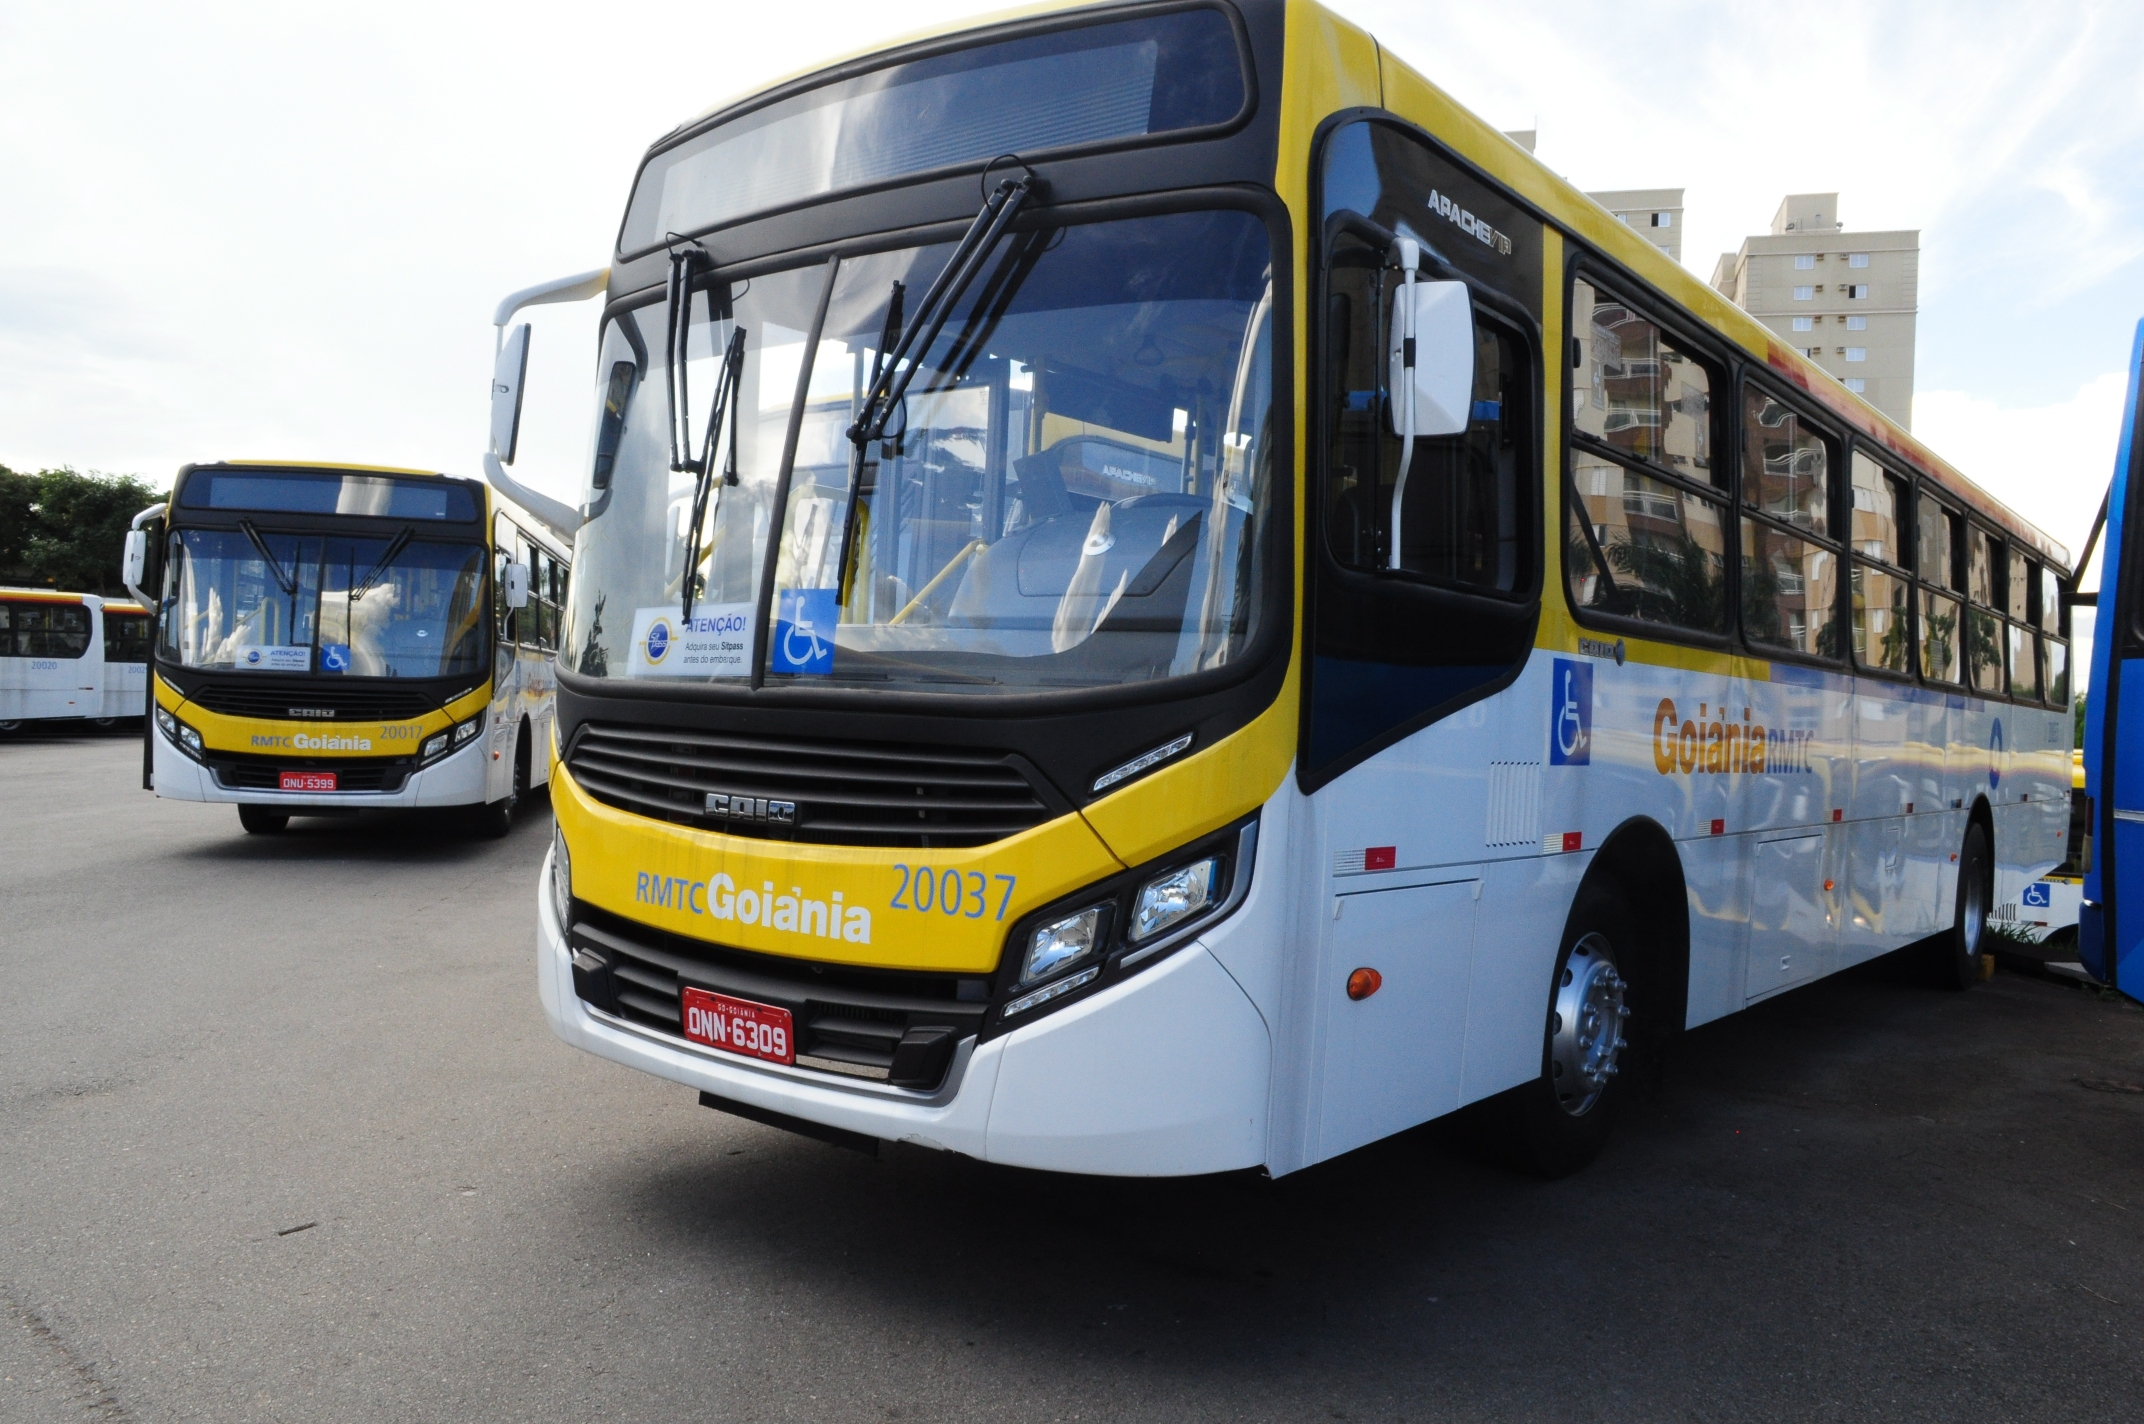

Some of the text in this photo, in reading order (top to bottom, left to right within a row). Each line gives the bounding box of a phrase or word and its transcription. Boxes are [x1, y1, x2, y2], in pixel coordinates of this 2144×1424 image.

[685, 613, 747, 636] ATENÇÃO!
[684, 642, 744, 653] Adquira seu Sitpass
[31, 661, 58, 670] 20020
[683, 654, 743, 666] antes do embarque.
[128, 665, 147, 674] 2002
[379, 725, 424, 739] 20017
[251, 735, 291, 748] RMTC
[636, 871, 705, 914] RMTC
[889, 863, 1017, 921] 20037
[688, 1006, 787, 1057] ONN-6309
